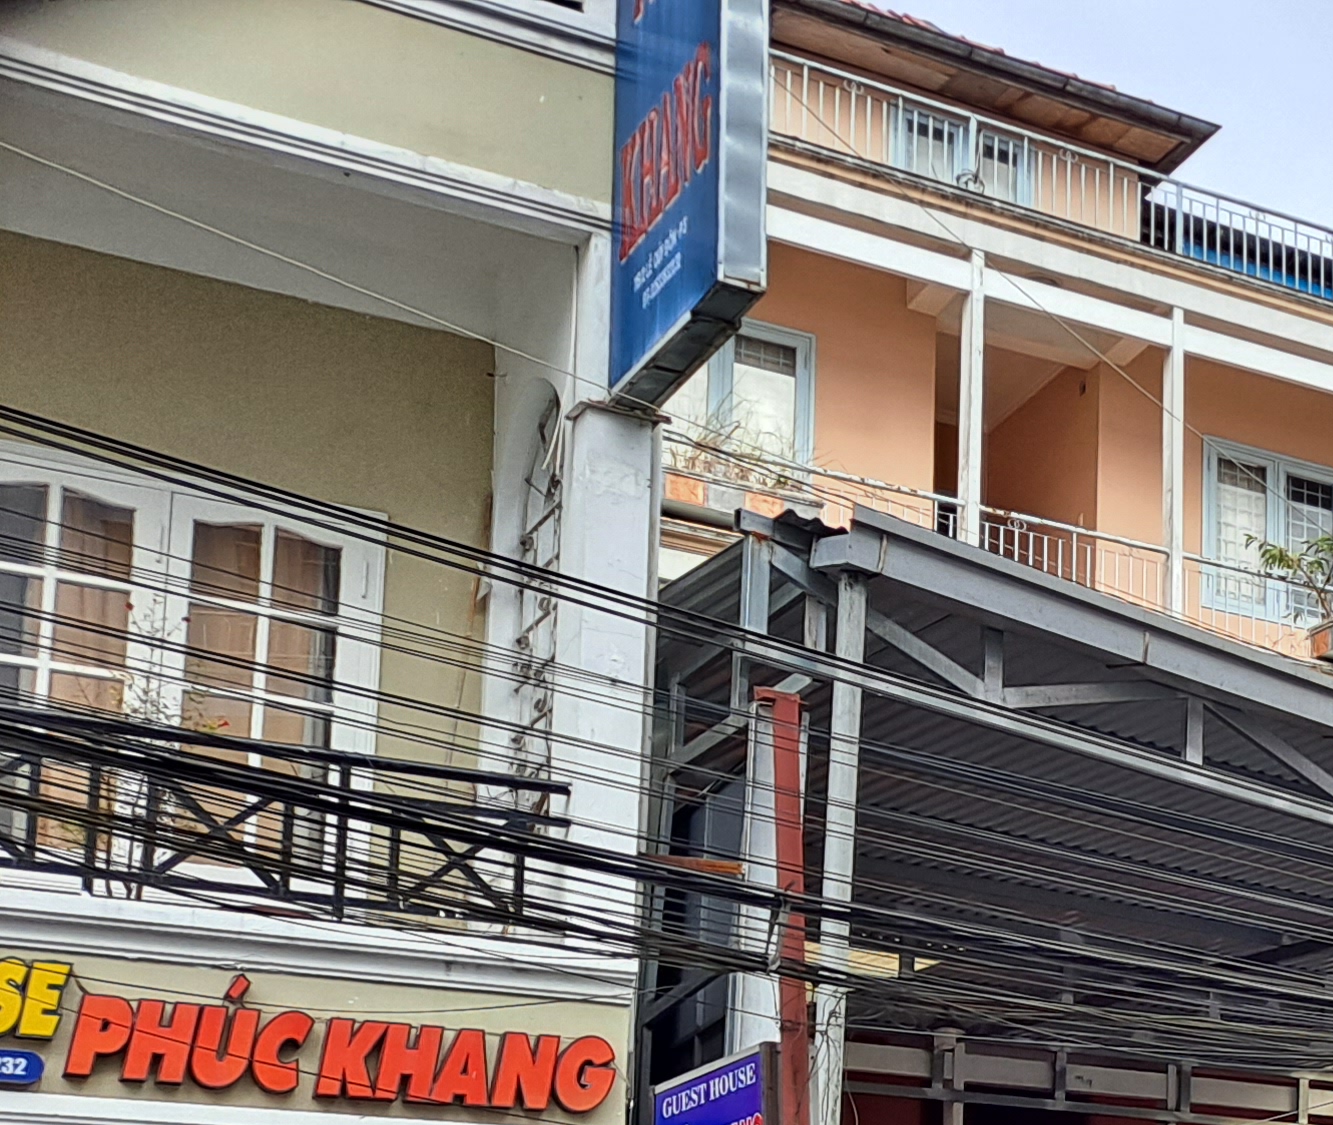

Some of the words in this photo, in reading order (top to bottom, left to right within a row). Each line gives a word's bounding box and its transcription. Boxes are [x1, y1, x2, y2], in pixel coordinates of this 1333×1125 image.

[620, 41, 711, 264] KHANG
[0, 1059, 27, 1075] 32
[62, 973, 315, 1094] PHÚC
[312, 1017, 616, 1113] KHANG
[662, 1082, 707, 1118] GUEST
[709, 1063, 756, 1101] HOUSE
